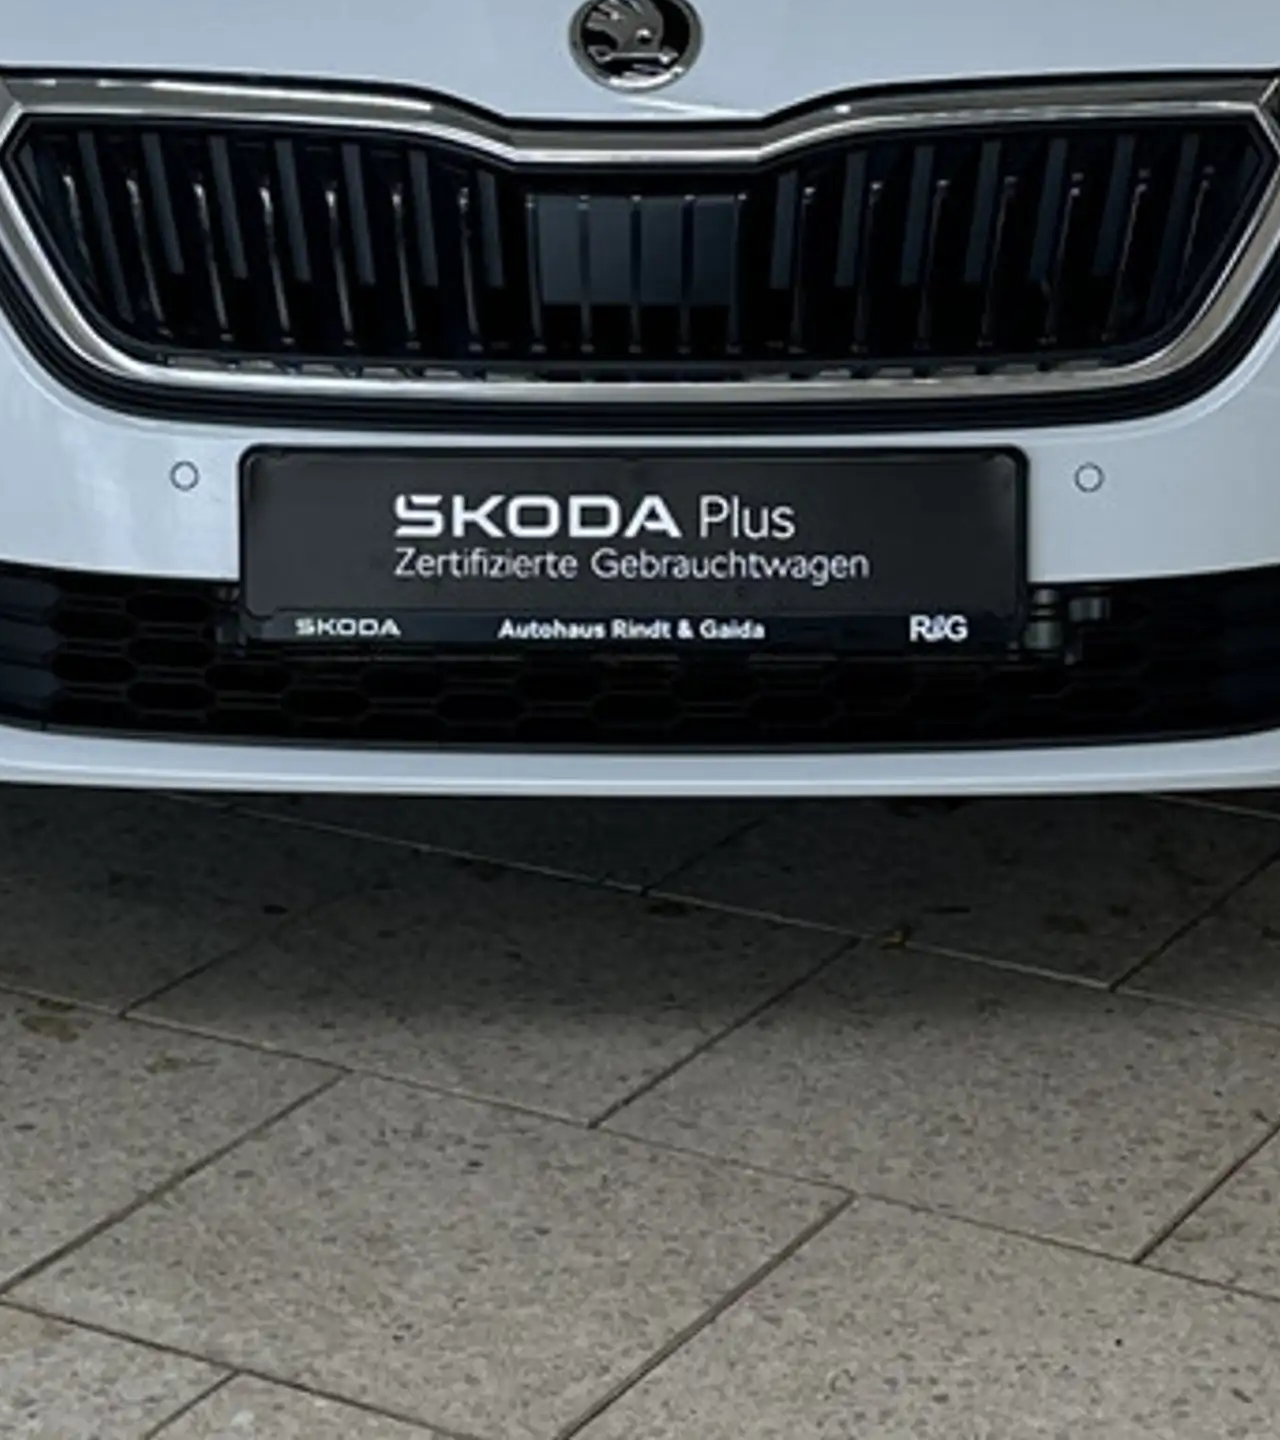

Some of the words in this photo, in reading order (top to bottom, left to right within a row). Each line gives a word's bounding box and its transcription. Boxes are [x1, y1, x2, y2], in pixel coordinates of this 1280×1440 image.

[699, 494, 796, 540] Plus
[394, 548, 578, 578] Zertifizierte
[591, 547, 870, 587] Gebrauchtwagen
[498, 618, 605, 639] Autohaus
[611, 618, 671, 639] Rindt
[677, 618, 694, 639] &
[699, 618, 765, 639] Gaida
